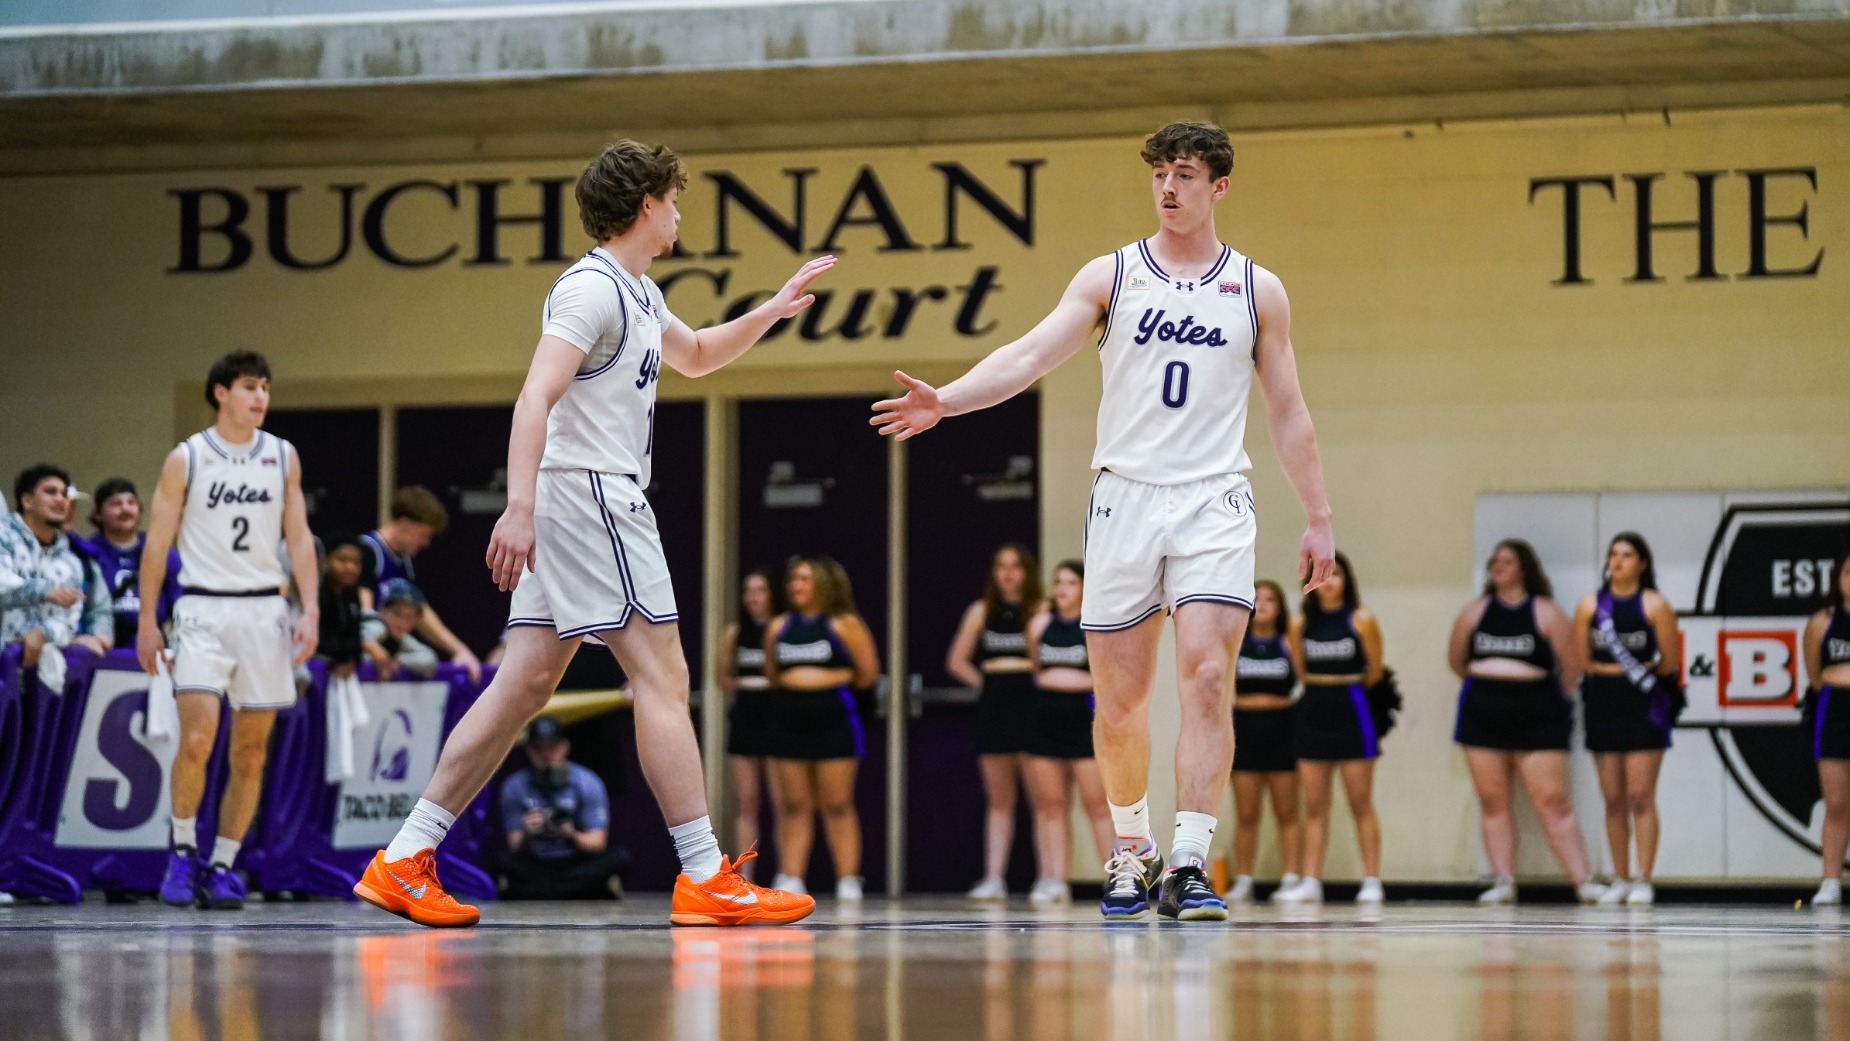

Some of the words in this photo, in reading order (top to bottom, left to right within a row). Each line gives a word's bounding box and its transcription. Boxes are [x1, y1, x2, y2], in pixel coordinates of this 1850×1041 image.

[167, 158, 1046, 274] BUCHNAN
[1527, 165, 1826, 287] THE
[1134, 307, 1228, 347] Yotes
[1162, 360, 1191, 410] 0
[207, 481, 272, 509] Yotes
[231, 514, 250, 552] 2
[1771, 559, 1836, 598] EST
[83, 688, 162, 831] S
